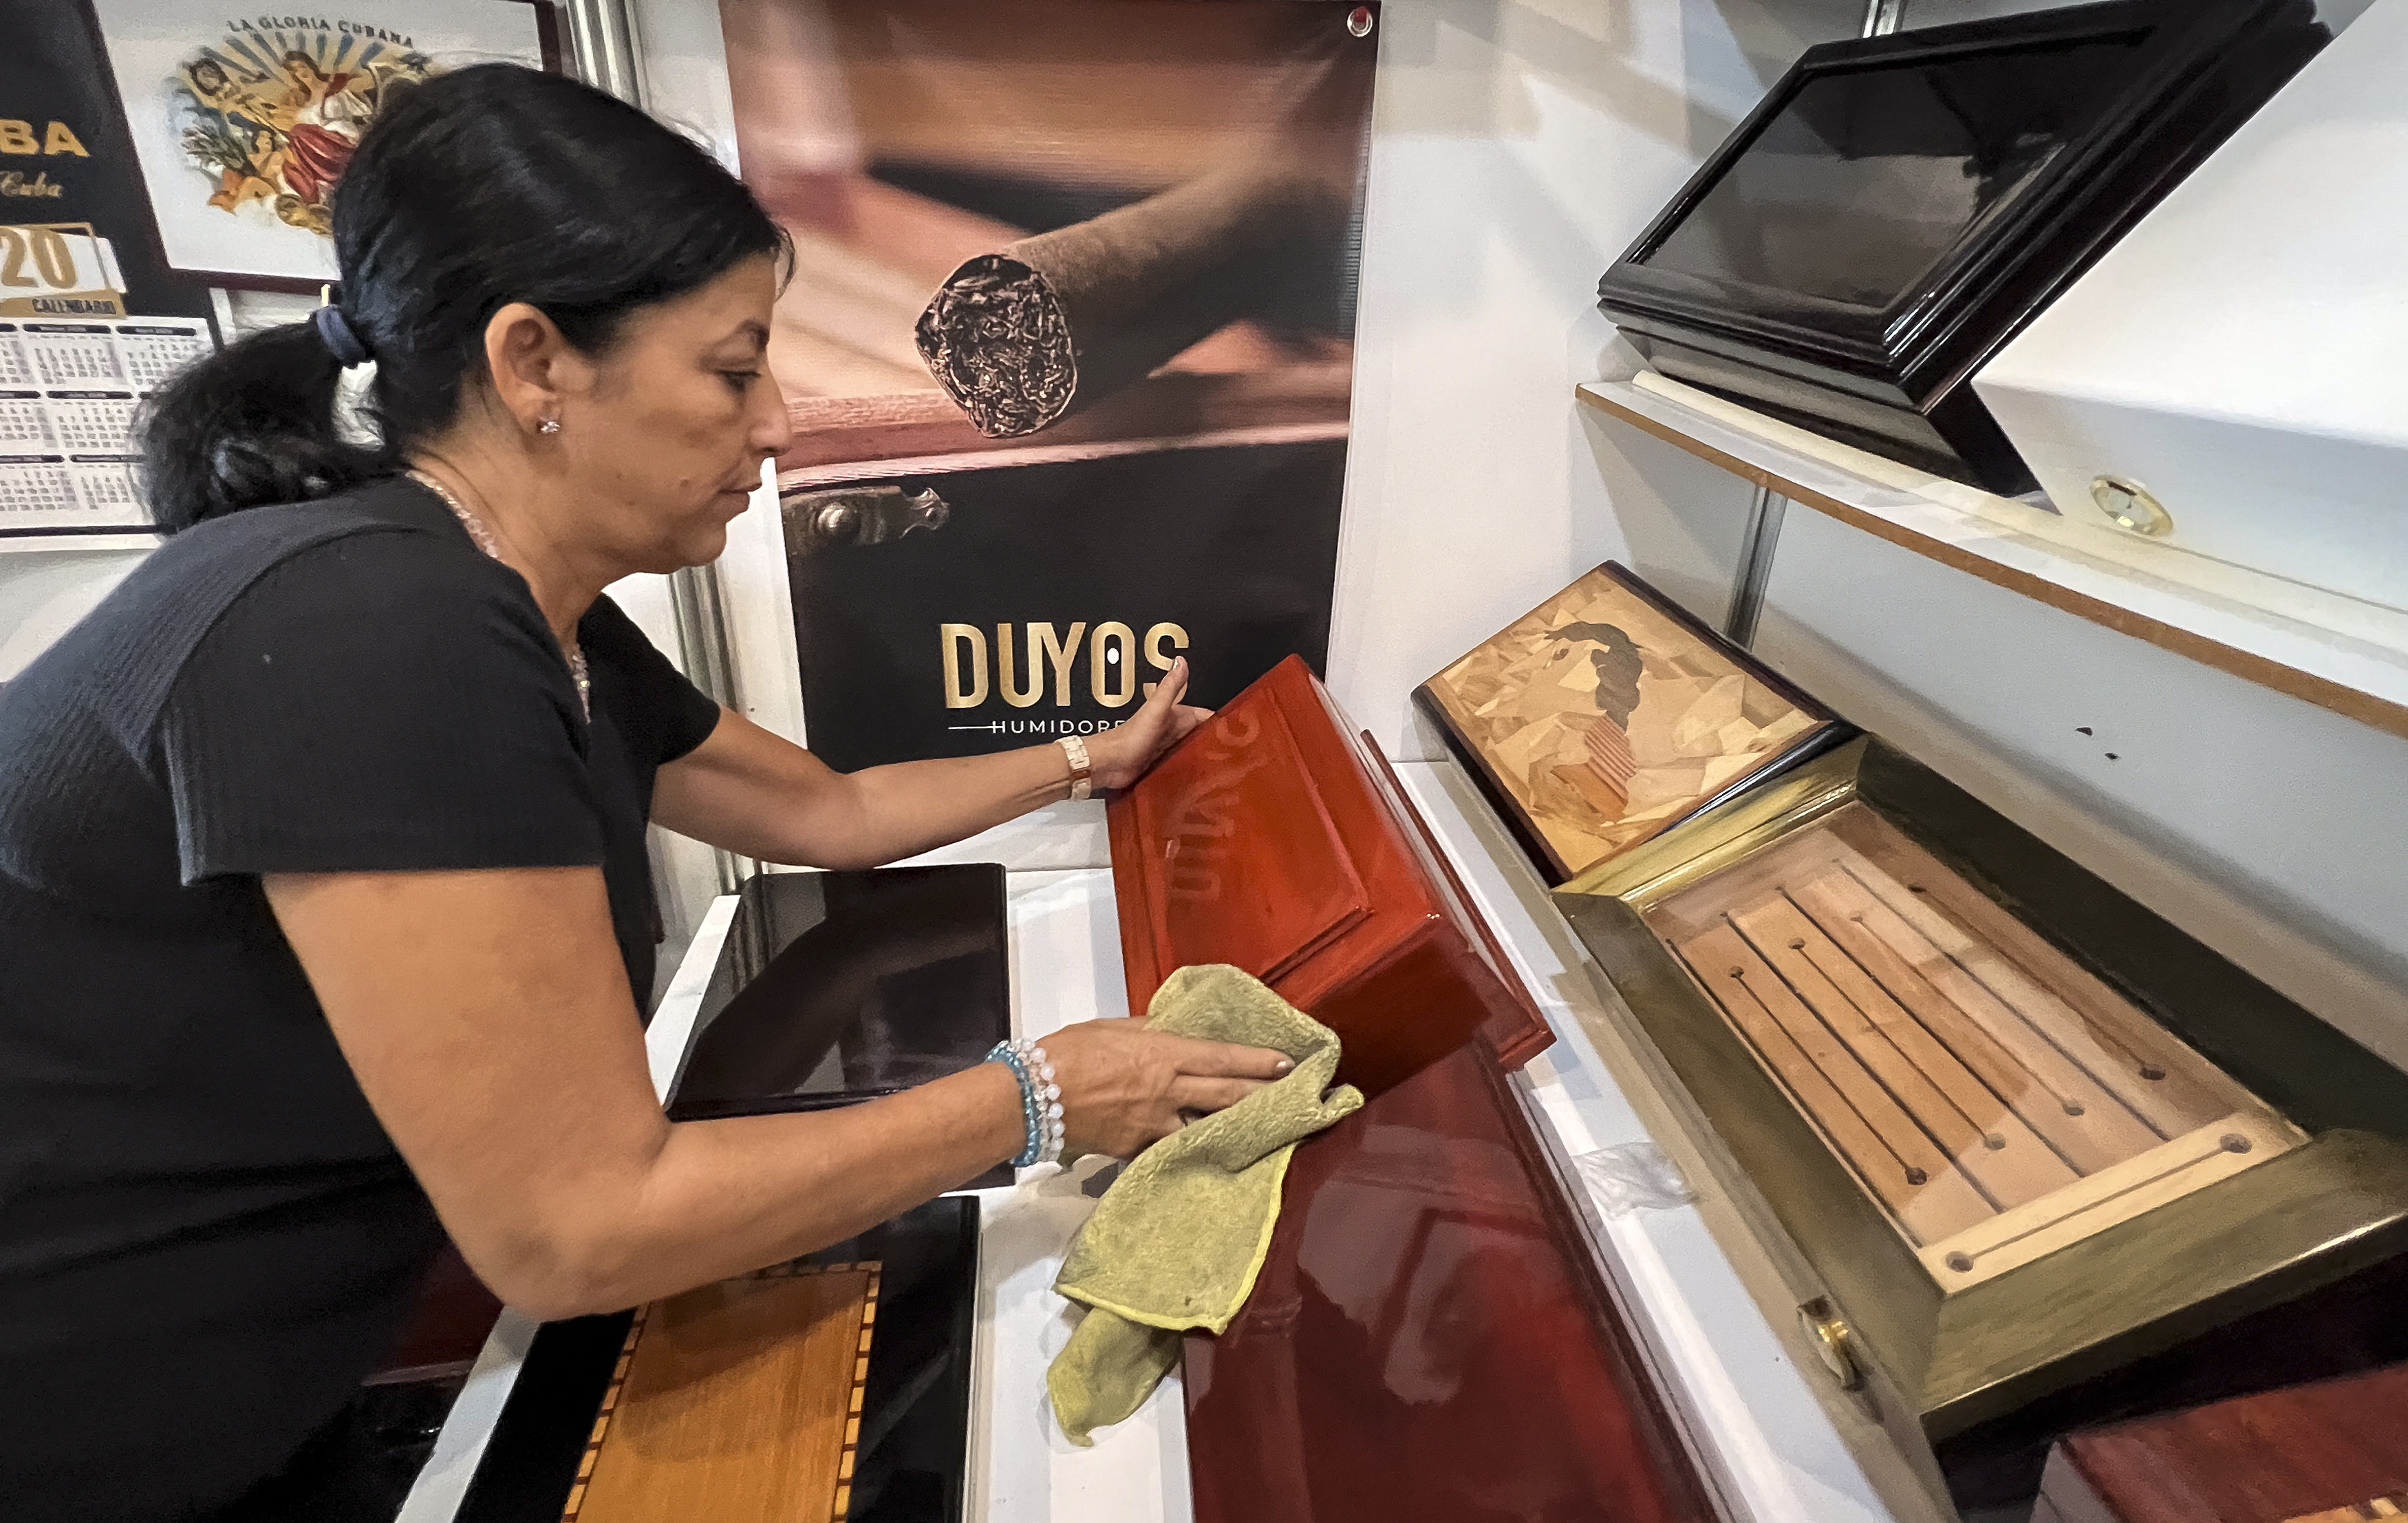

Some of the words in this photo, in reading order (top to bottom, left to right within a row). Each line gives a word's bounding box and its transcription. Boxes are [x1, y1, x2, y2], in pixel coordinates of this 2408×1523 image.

[226, 18, 253, 32] LA
[258, 16, 331, 31] GLORIA
[940, 621, 1190, 708] DUYOS
[992, 720, 1126, 734] HUMIDOR
